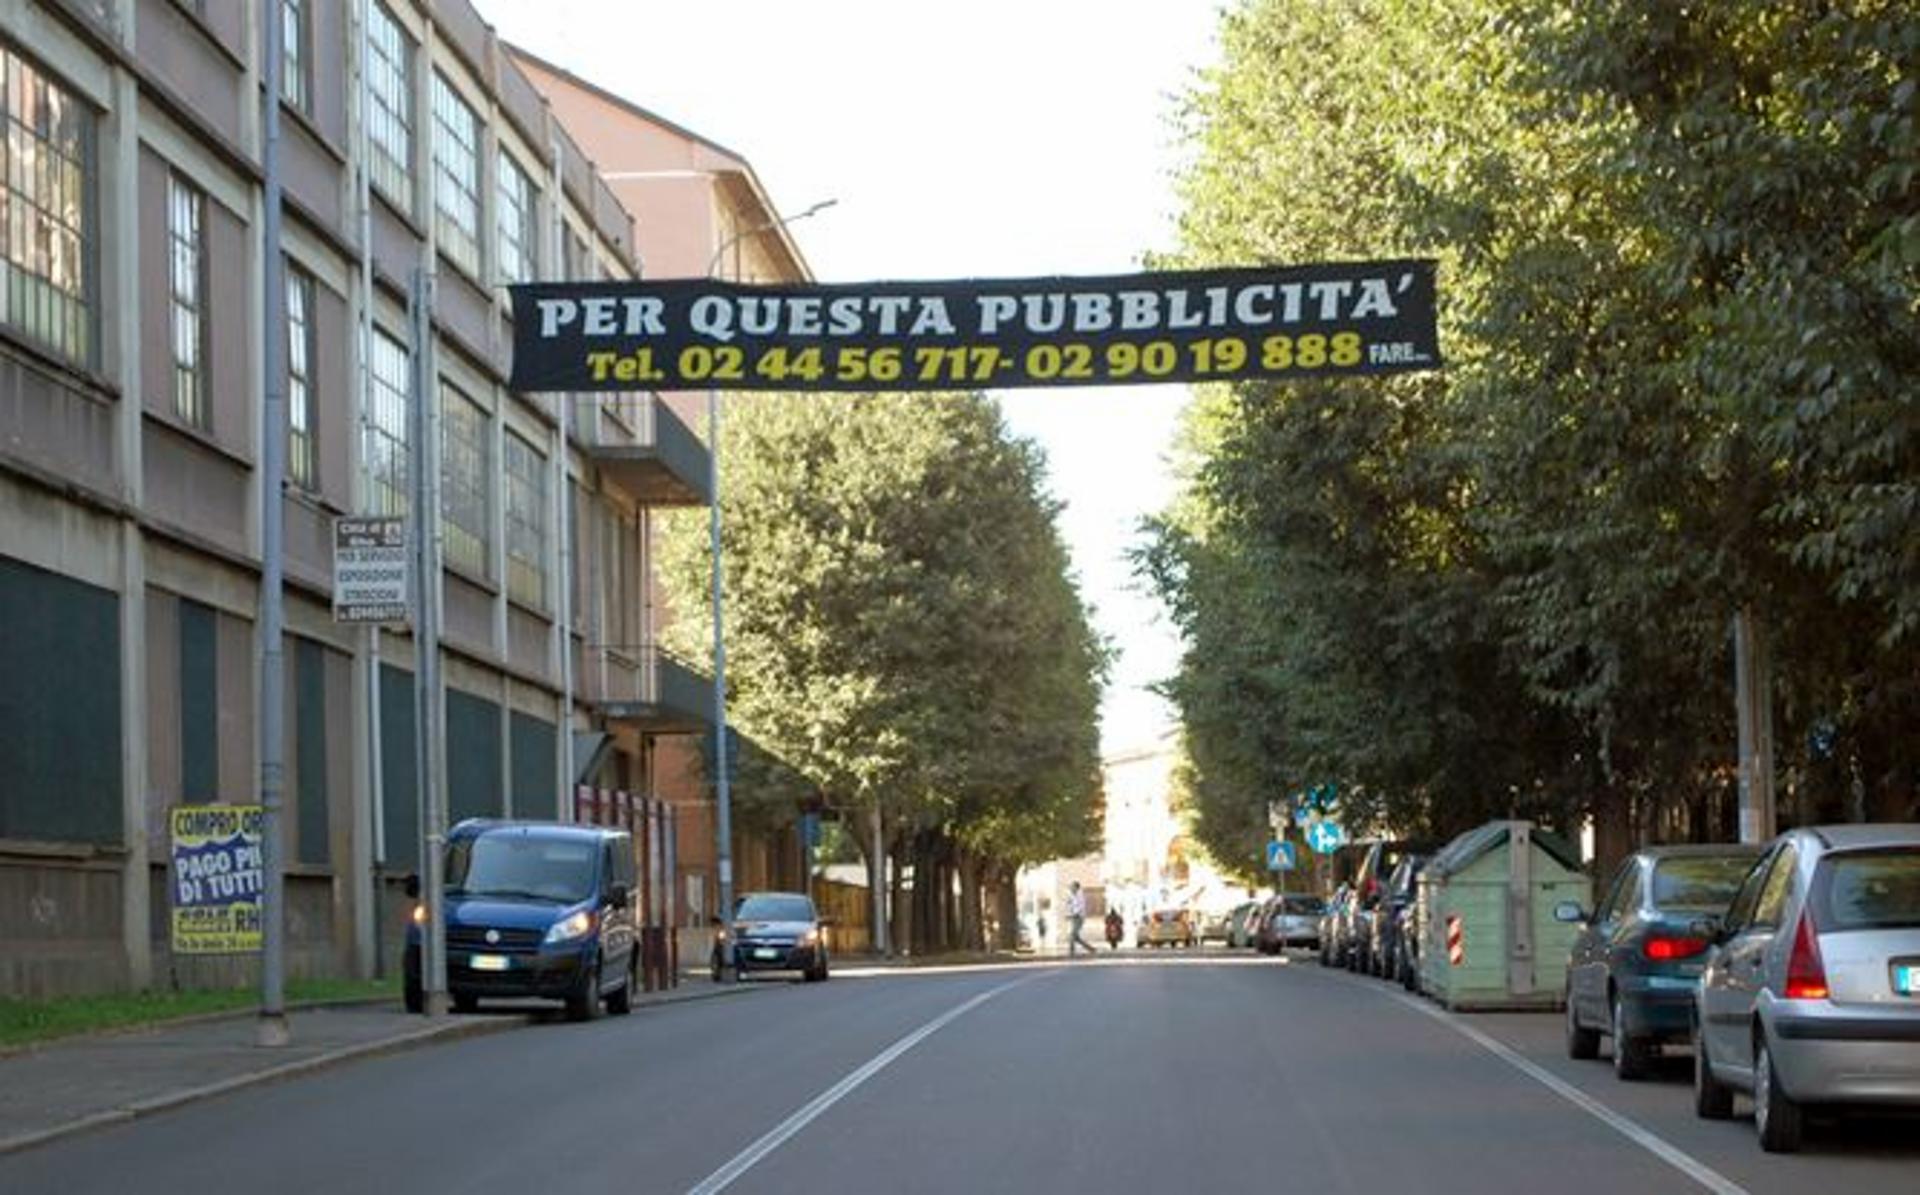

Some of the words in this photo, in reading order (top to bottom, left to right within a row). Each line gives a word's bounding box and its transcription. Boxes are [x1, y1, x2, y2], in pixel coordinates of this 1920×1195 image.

[538, 296, 666, 338] PER
[690, 296, 956, 342] QUESTA
[587, 352, 664, 382] Tel.
[678, 347, 745, 380] 02
[757, 347, 824, 381] 44
[837, 347, 901, 381] 56
[1026, 344, 1093, 379] 02
[1106, 341, 1177, 377] 90
[1191, 337, 1247, 373] 19
[1262, 332, 1362, 370] 888
[176, 811, 238, 836] COMPRO
[241, 811, 262, 834] OR
[176, 851, 231, 879] PAGO
[180, 877, 202, 903] DI
[208, 869, 263, 898] TUTTI
[235, 908, 261, 932] RH
